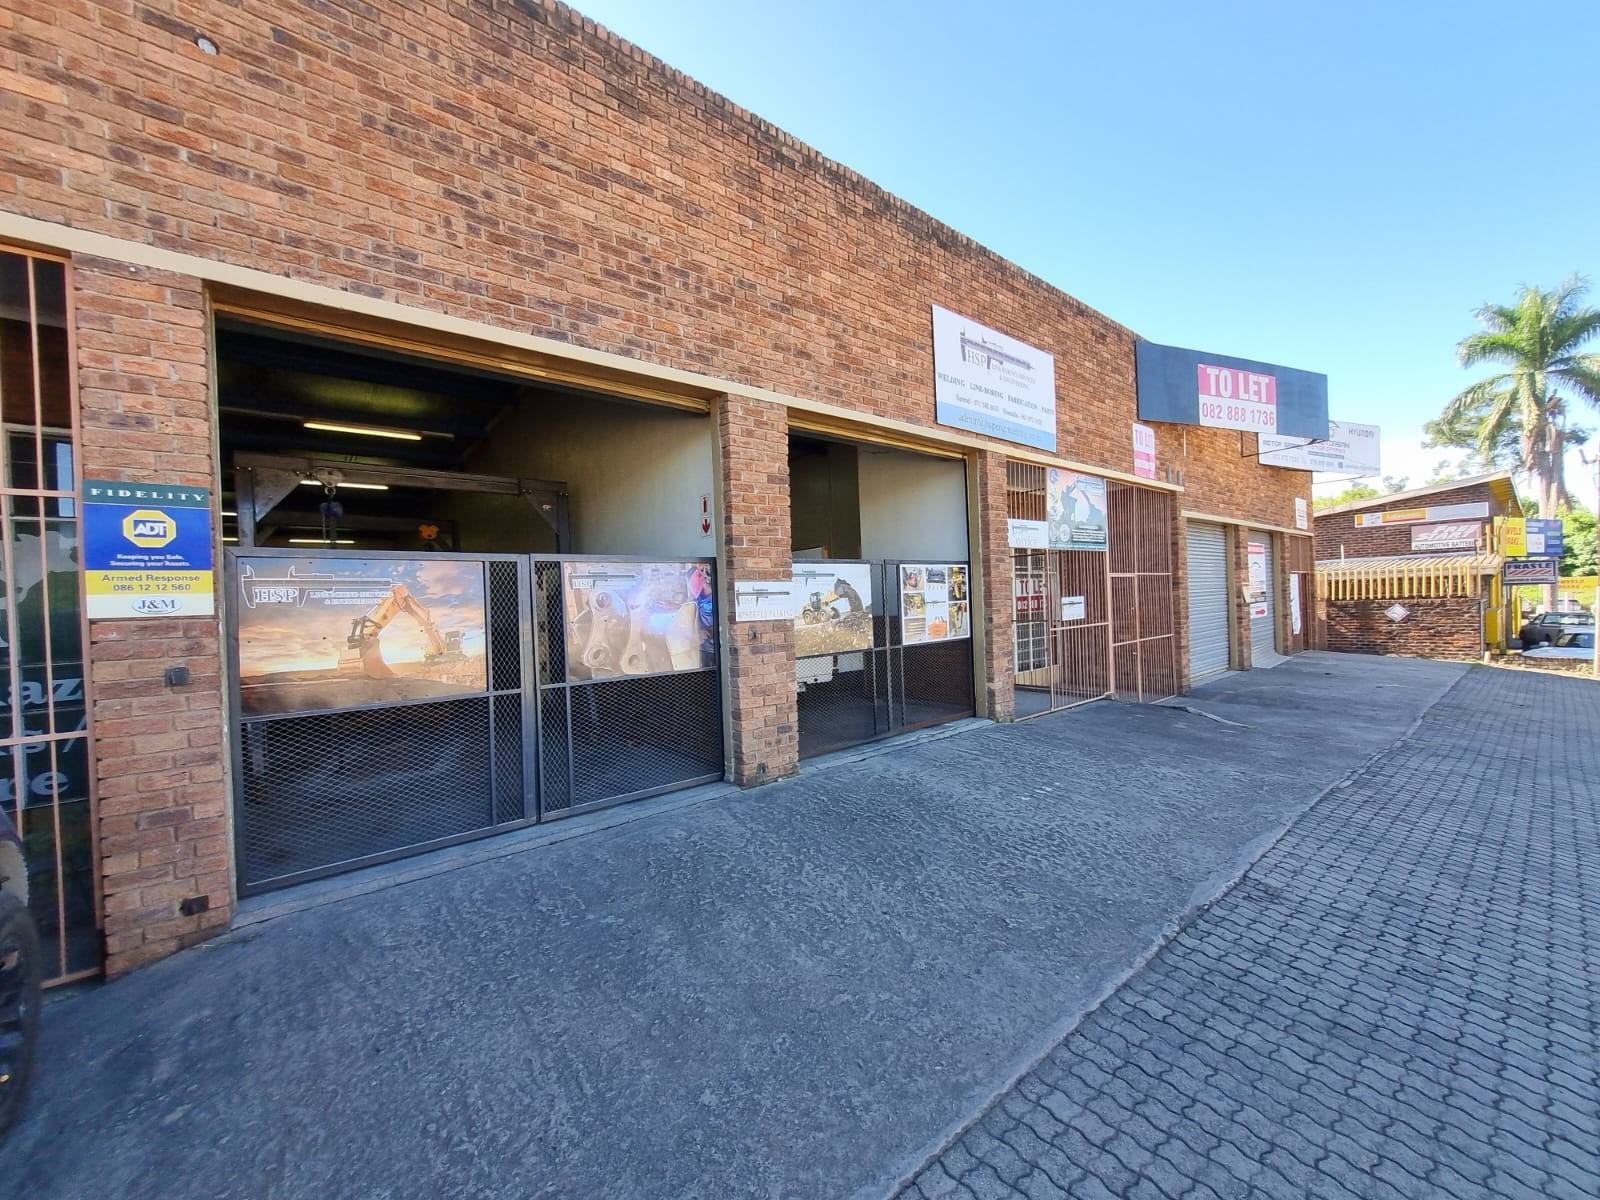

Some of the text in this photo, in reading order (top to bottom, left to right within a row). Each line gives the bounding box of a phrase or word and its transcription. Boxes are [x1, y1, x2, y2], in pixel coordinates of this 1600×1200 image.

[1206, 367, 1269, 403] TO LET
[1202, 402, 1275, 426] 082 888 1736
[90, 488, 205, 501] FIDELITY
[134, 522, 167, 536] ADT
[102, 574, 201, 583] Armed Response
[113, 583, 191, 592] 086 12 12 560
[255, 588, 298, 602] HSP
[137, 599, 176, 610] J&M
